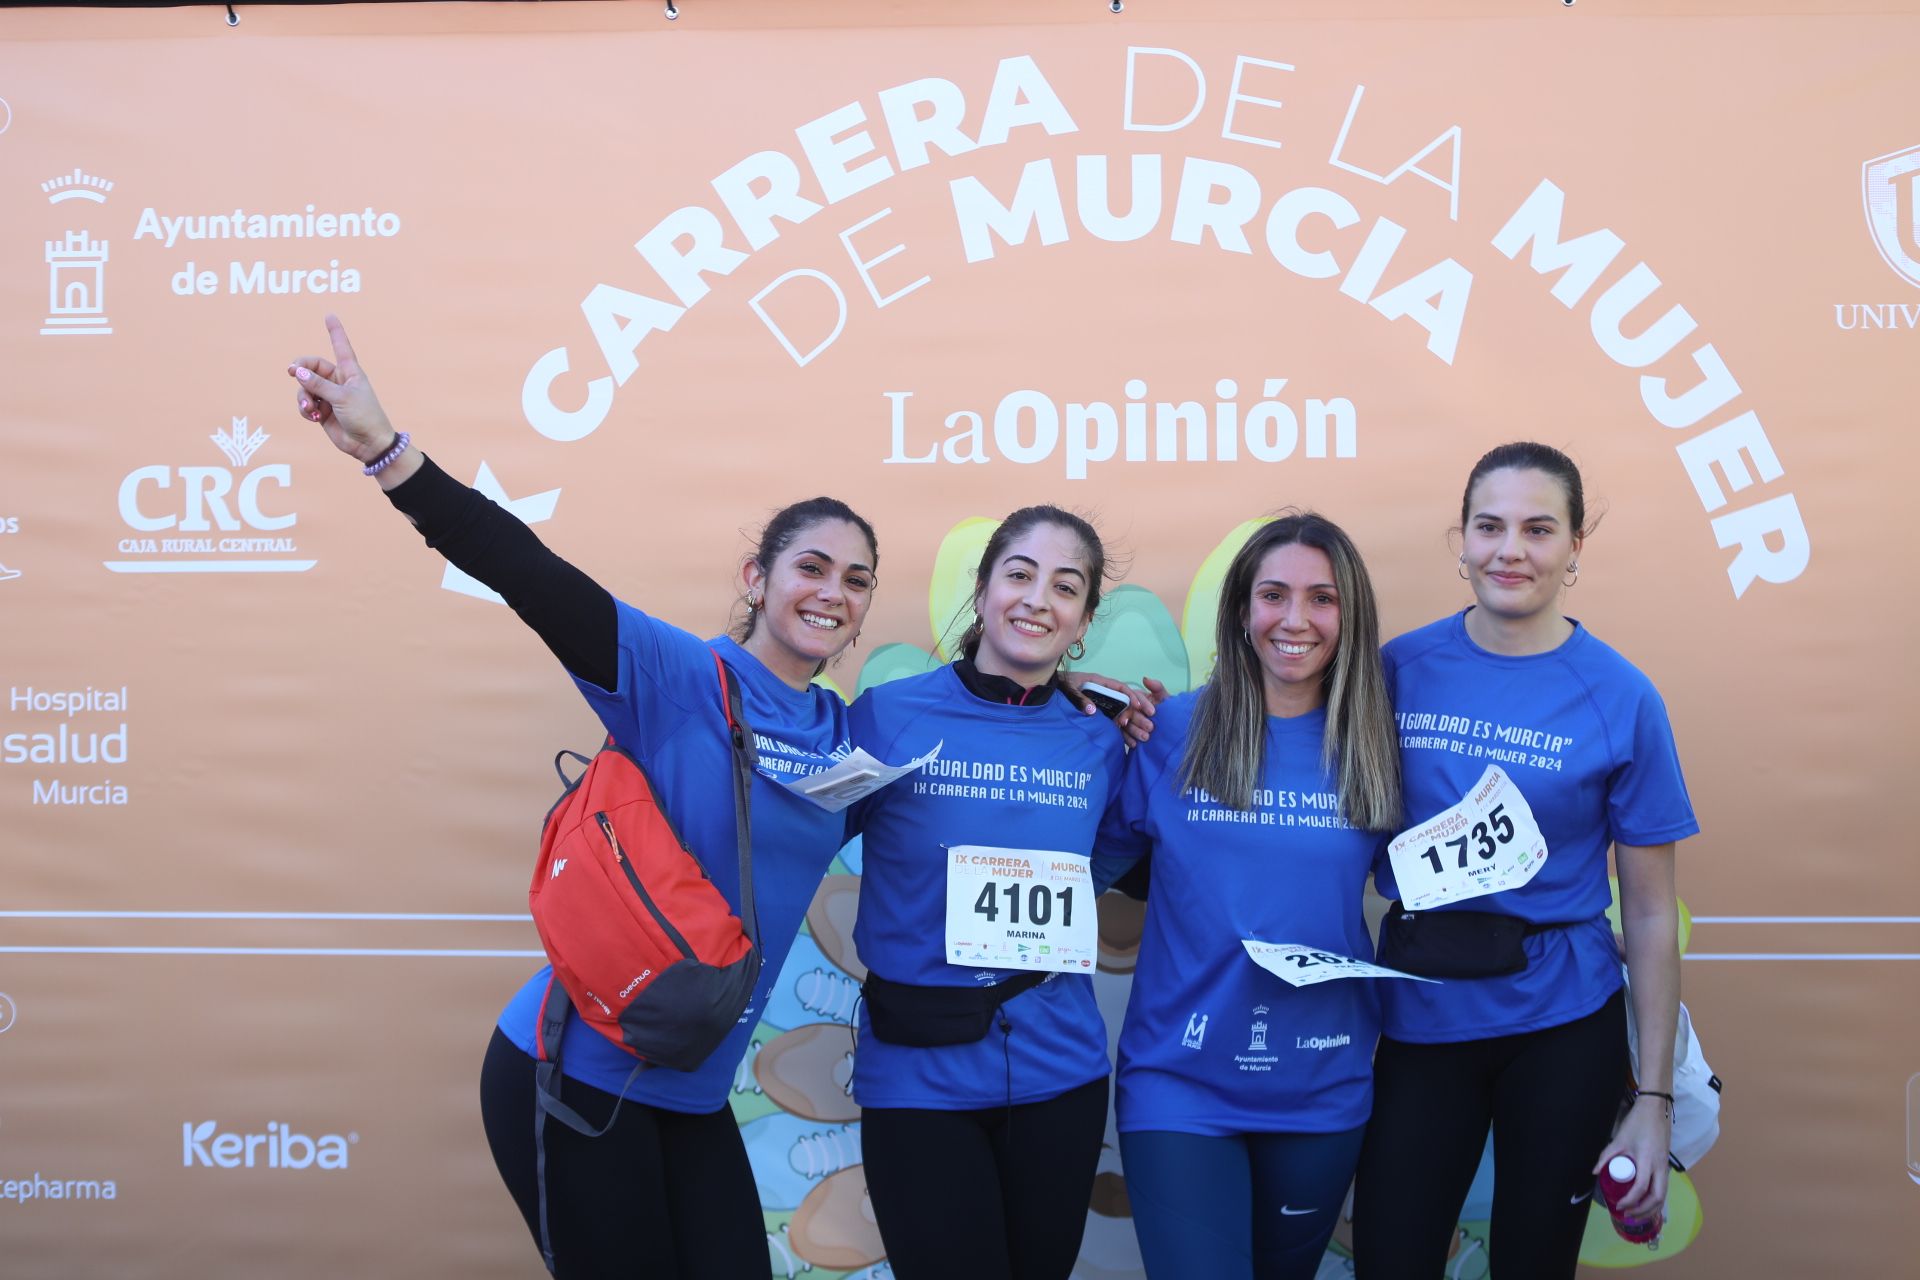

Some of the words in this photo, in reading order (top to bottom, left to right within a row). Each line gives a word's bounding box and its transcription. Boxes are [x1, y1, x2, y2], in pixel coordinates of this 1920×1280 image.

[134, 204, 400, 247] Ayuntamiento
[747, 207, 931, 367] DE
[949, 154, 1473, 366] MURCIA
[171, 264, 218, 295] de
[229, 260, 361, 294] Murcia
[522, 55, 1079, 441] CARRERA
[1124, 46, 1295, 148] DE
[1329, 84, 1461, 221] LA
[1491, 178, 1810, 600] MUJER
[882, 378, 1357, 479] LaOpinión
[118, 464, 297, 531] CRC
[118, 539, 157, 553] CAJA
[161, 538, 216, 552] RURAL
[218, 537, 297, 552] CENTRAL
[11, 686, 128, 717] Hospital
[1472, 720, 1492, 739] ES
[1404, 736, 1448, 750] CARRERA
[1450, 740, 1466, 755] DE
[1467, 743, 1483, 757] LA
[1484, 747, 1527, 765] MUJER
[1529, 754, 1562, 772] 2024
[1010, 765, 1027, 783] ES
[32, 779, 128, 805] Murcia
[914, 782, 926, 794] IX
[930, 782, 987, 799] CARRERA
[991, 787, 1005, 800] DE
[1010, 790, 1025, 802] LA
[1027, 790, 1064, 807] MUJER
[1067, 795, 1088, 809] 2024
[1279, 791, 1296, 808] ES
[1302, 792, 1338, 810] MUR
[1474, 771, 1501, 806] MURCIA
[1187, 810, 1199, 822] IX
[1202, 809, 1257, 824] CARRERA
[1260, 812, 1275, 825] DE
[1280, 814, 1294, 826] LA
[1299, 815, 1341, 830] MUJER
[1409, 812, 1464, 843] CARRERA
[1431, 818, 1469, 842] MUJER
[1420, 803, 1515, 874] 1735
[955, 855, 967, 864] IX
[971, 856, 1031, 869] CARRERA
[992, 867, 1034, 878] MUJER
[1051, 862, 1087, 874] MURCIA
[1468, 863, 1497, 878] MERY
[974, 882, 1073, 927] 4101
[1006, 930, 1046, 940] MARINA
[619, 969, 651, 998] Quechua
[1234, 1055, 1279, 1063] Ayuntamiento
[1249, 1064, 1272, 1072] Murcia
